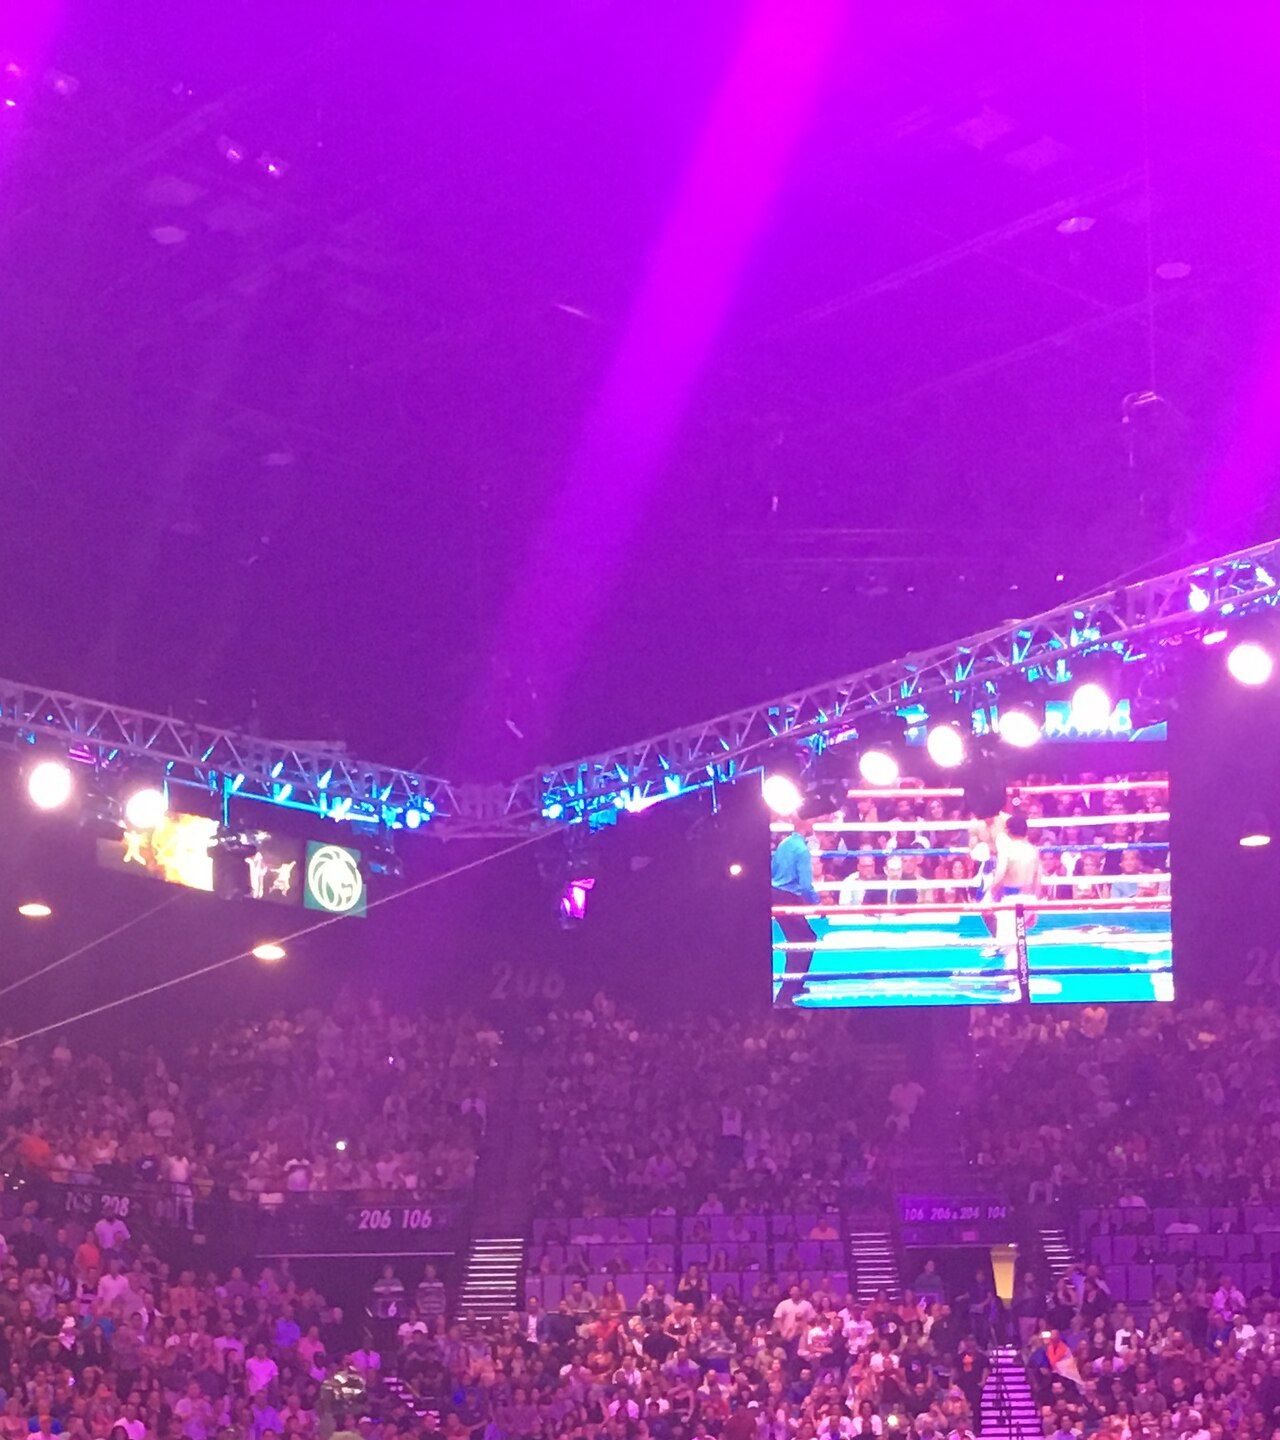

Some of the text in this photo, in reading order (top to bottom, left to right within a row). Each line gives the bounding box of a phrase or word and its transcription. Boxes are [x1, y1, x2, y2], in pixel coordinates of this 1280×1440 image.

[489, 963, 565, 999] 206
[358, 1209, 433, 1230] 206 106
